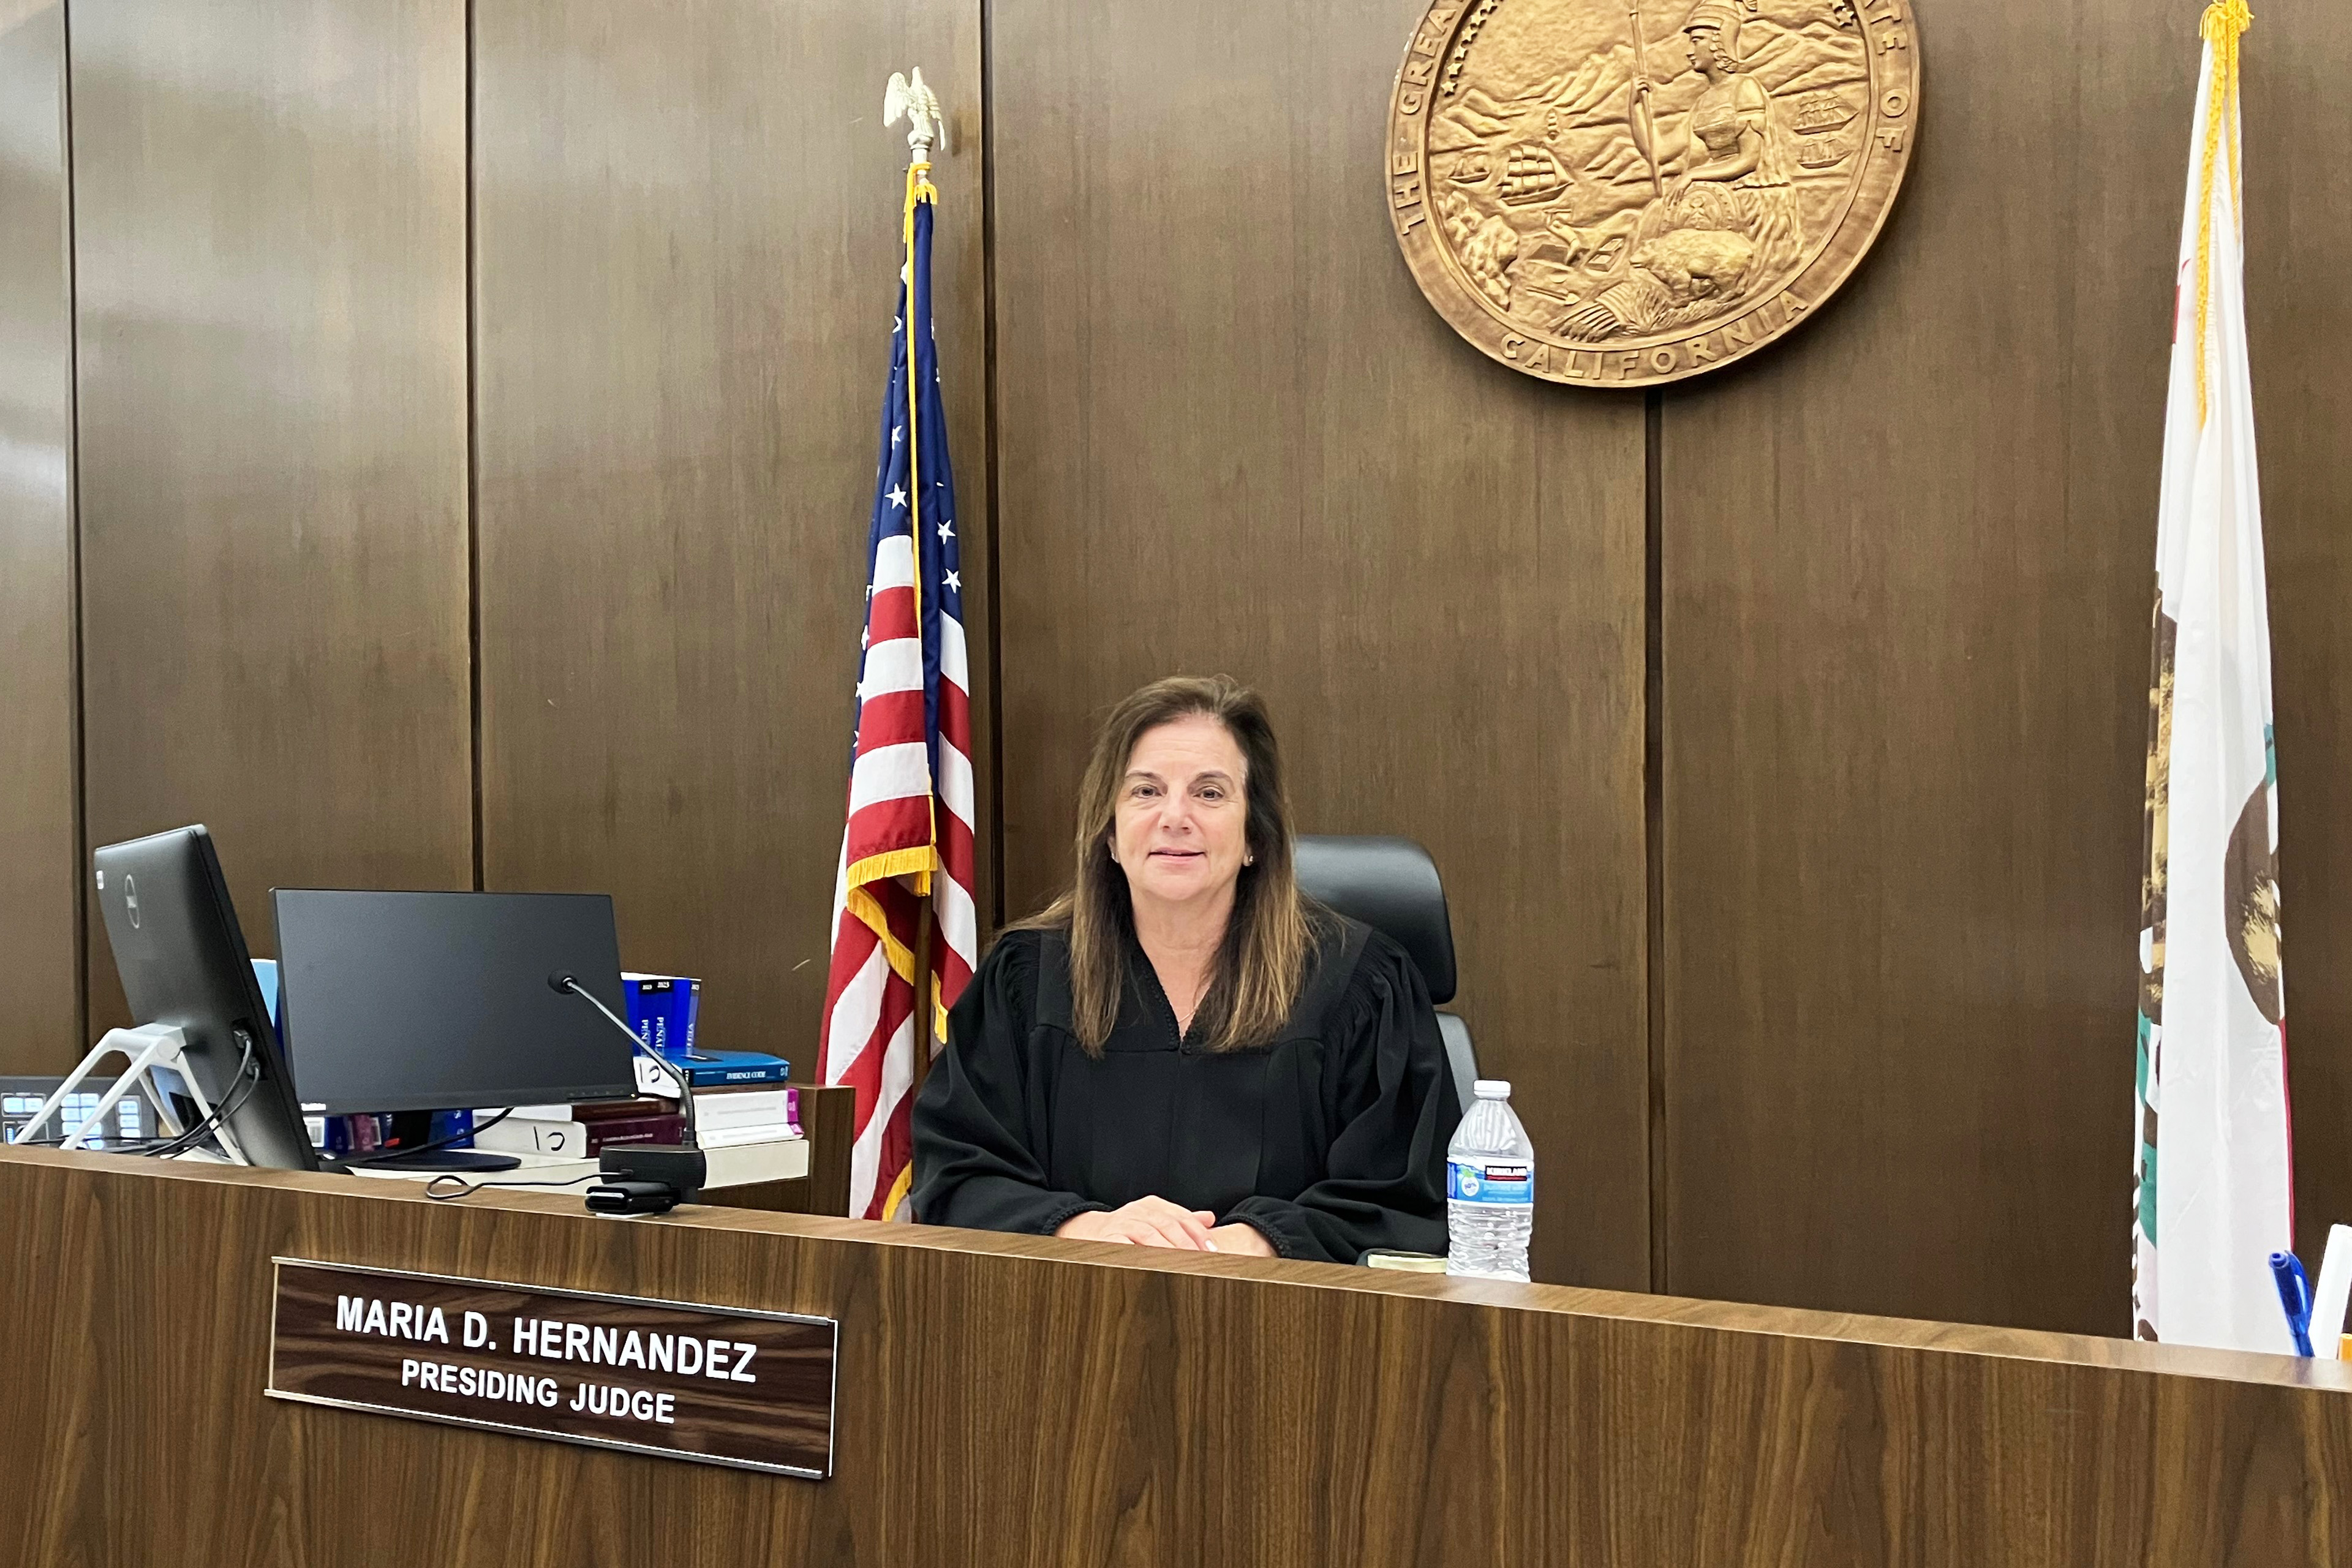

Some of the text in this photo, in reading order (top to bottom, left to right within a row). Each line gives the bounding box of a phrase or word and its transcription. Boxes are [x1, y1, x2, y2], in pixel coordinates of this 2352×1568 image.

[1398, 0, 1465, 115] GREA
[1876, 88, 1910, 153] OF
[1392, 151, 1426, 236] THE
[1500, 290, 1809, 380] CALIFORNIA
[336, 1295, 757, 1383] MARIA D. HERNANDEZ
[401, 1359, 675, 1424] PRESIDING JUDGE
